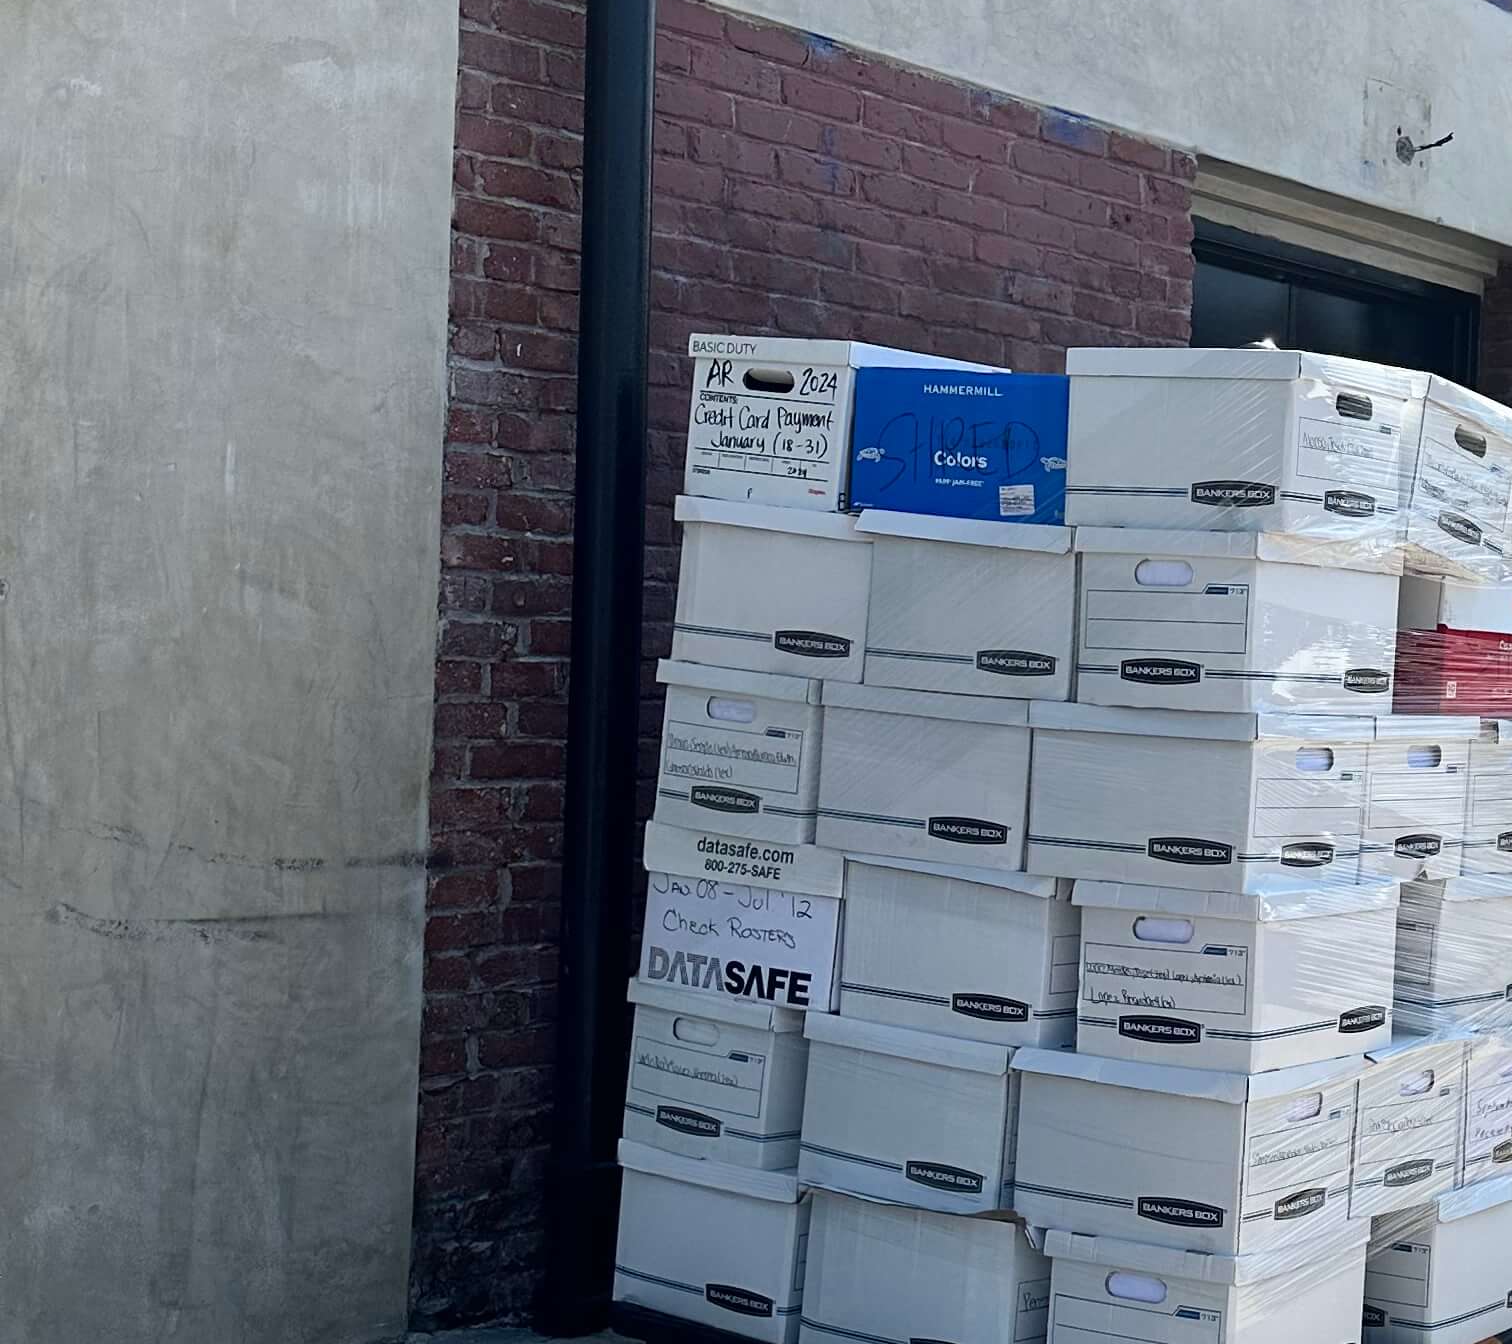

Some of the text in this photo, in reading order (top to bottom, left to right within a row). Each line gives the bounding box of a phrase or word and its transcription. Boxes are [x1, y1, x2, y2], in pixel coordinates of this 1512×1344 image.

[692, 340, 757, 355] BASIC DUTY
[706, 358, 734, 389] AR
[799, 367, 838, 401] 2024
[923, 384, 1002, 397] HAMMERMILL
[694, 404, 835, 433] Credit Card Payment
[710, 430, 765, 453] January
[878, 412, 1040, 492] SHRED
[933, 450, 988, 469] Colors
[1196, 488, 1271, 499] BANKERS BOX
[779, 637, 846, 652] BANKERS BOX
[981, 656, 1051, 670] BANKERS BOX
[1125, 666, 1196, 677] BANKERS BOX
[694, 791, 756, 809] BANKERS BOX
[932, 823, 1003, 840] BANKERS BOX
[697, 836, 794, 865] datasafe.com
[1153, 843, 1228, 858] BANKERS BOX
[704, 858, 781, 880] 800-275-SAFE
[696, 878, 719, 900] 08
[662, 909, 720, 937] Check
[648, 946, 812, 1007] DATASAFE
[956, 999, 1024, 1017] BANKERS BOX
[1123, 1021, 1197, 1037] BANKERS BOX
[659, 1111, 717, 1132] BANKERS BOX
[910, 1166, 978, 1188] BANKERS BOX
[1142, 1203, 1219, 1222] BANKERS BOX
[709, 1289, 769, 1312] BANKERS BOX
